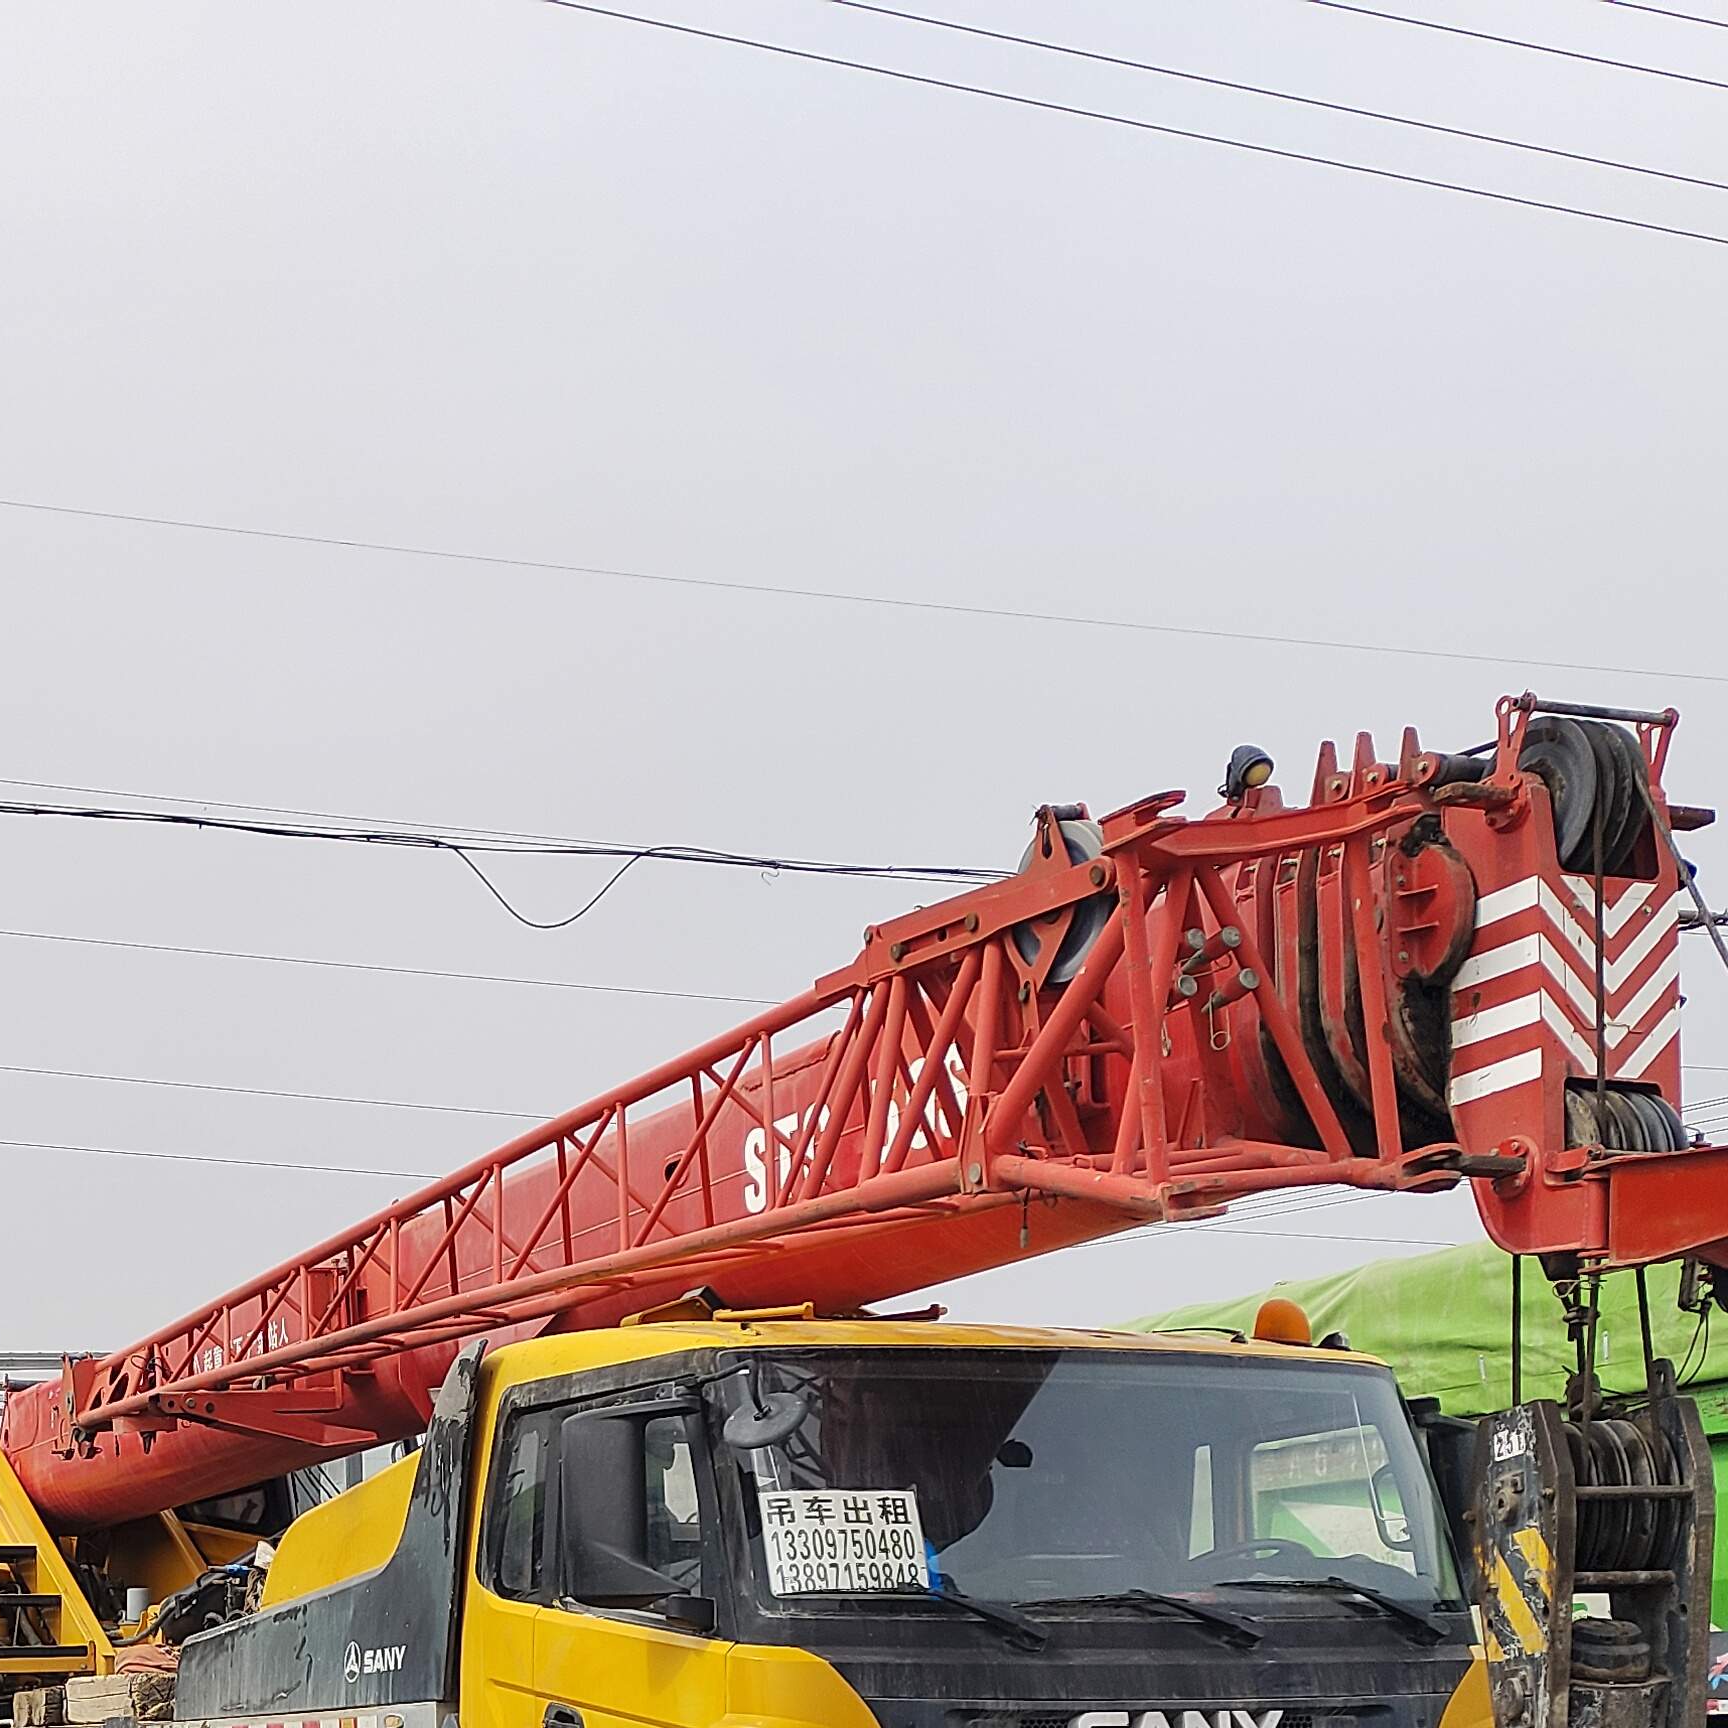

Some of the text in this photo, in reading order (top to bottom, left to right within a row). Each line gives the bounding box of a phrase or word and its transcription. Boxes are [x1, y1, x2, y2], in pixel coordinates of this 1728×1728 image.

[766, 1496, 912, 1526] 吊车出租
[771, 1528, 916, 1561] 13309750480
[363, 1645, 407, 1674] SANY
